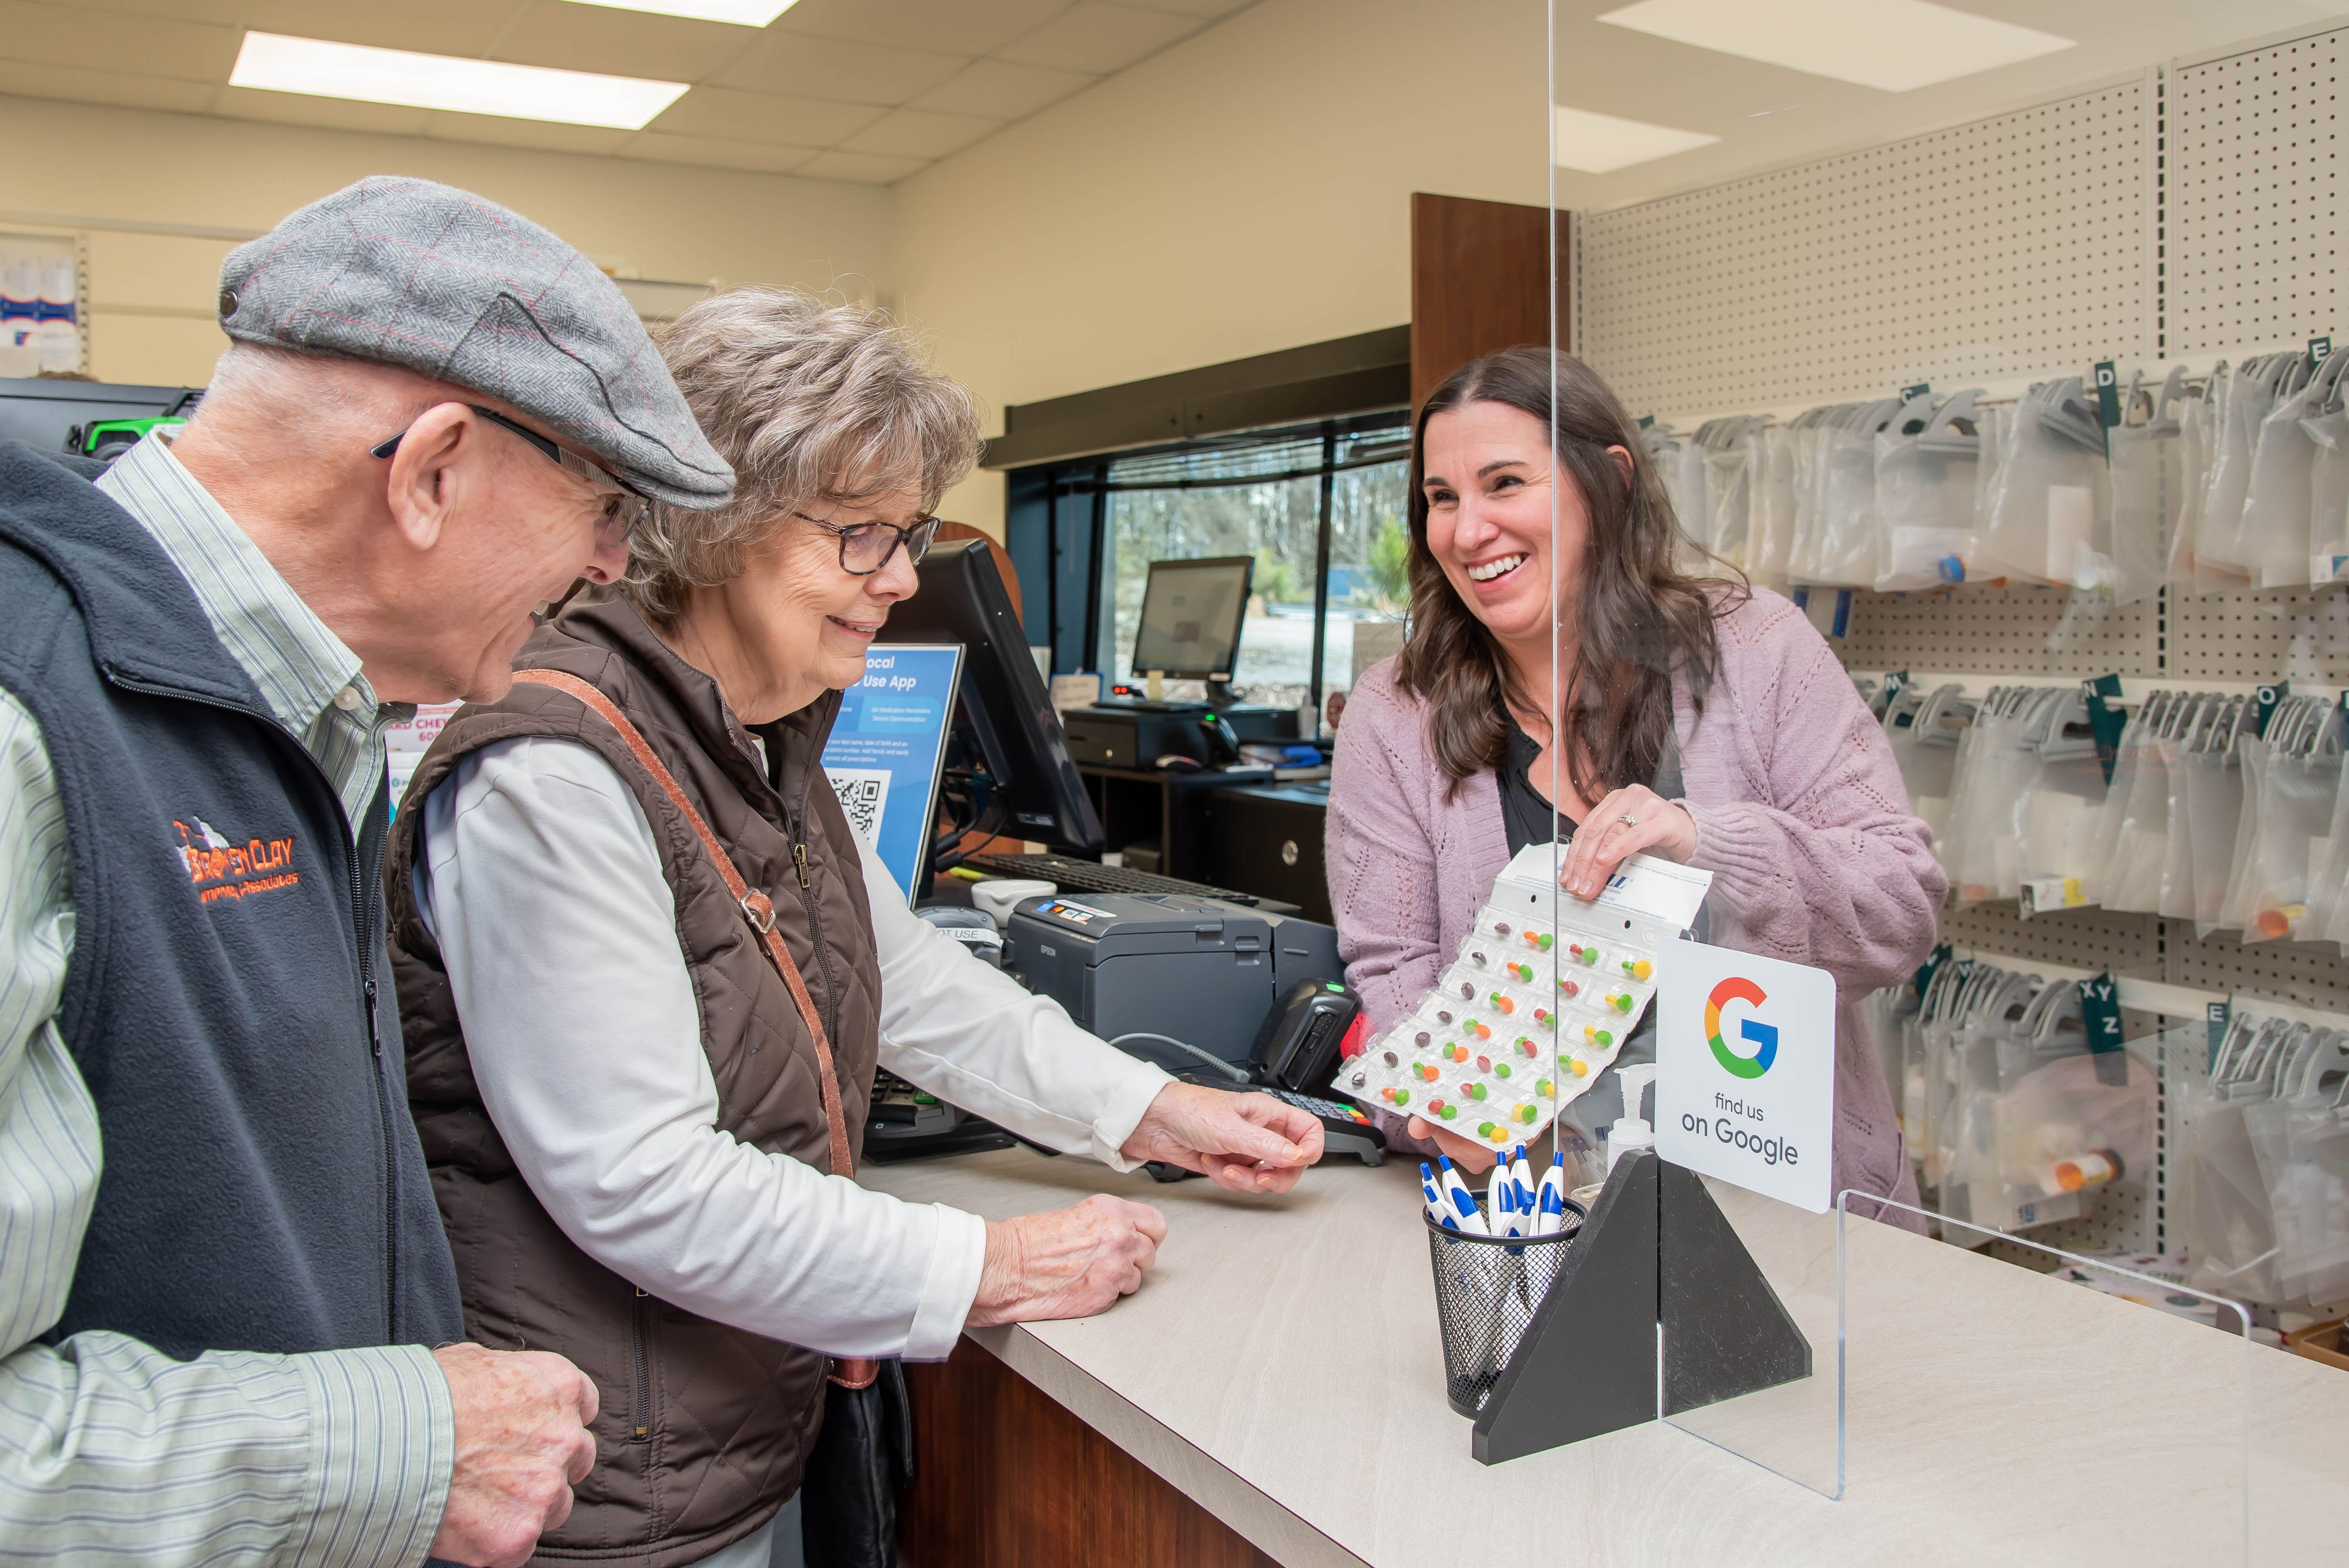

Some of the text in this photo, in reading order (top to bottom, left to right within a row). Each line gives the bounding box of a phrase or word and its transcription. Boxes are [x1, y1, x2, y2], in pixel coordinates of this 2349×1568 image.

[2313, 342, 2328, 362] E
[2097, 369, 2114, 386] D
[1901, 389, 1915, 406] C
[867, 656, 895, 669] ocal
[863, 675, 887, 688] Use
[889, 675, 917, 692] App
[1884, 674, 1903, 690] M
[2082, 681, 2097, 698] N
[2258, 688, 2276, 704] O
[416, 718, 446, 729] CHE
[249, 837, 292, 870] CLAY
[955, 930, 979, 938] USE
[1041, 945, 1056, 957] EPSON
[2081, 980, 2112, 1002] X Y
[2209, 1005, 2224, 1023] E
[1704, 976, 1778, 1079] G
[2103, 1017, 2119, 1034] Z
[1714, 1092, 1764, 1121] find us
[1682, 1113, 1798, 1166] on Google
